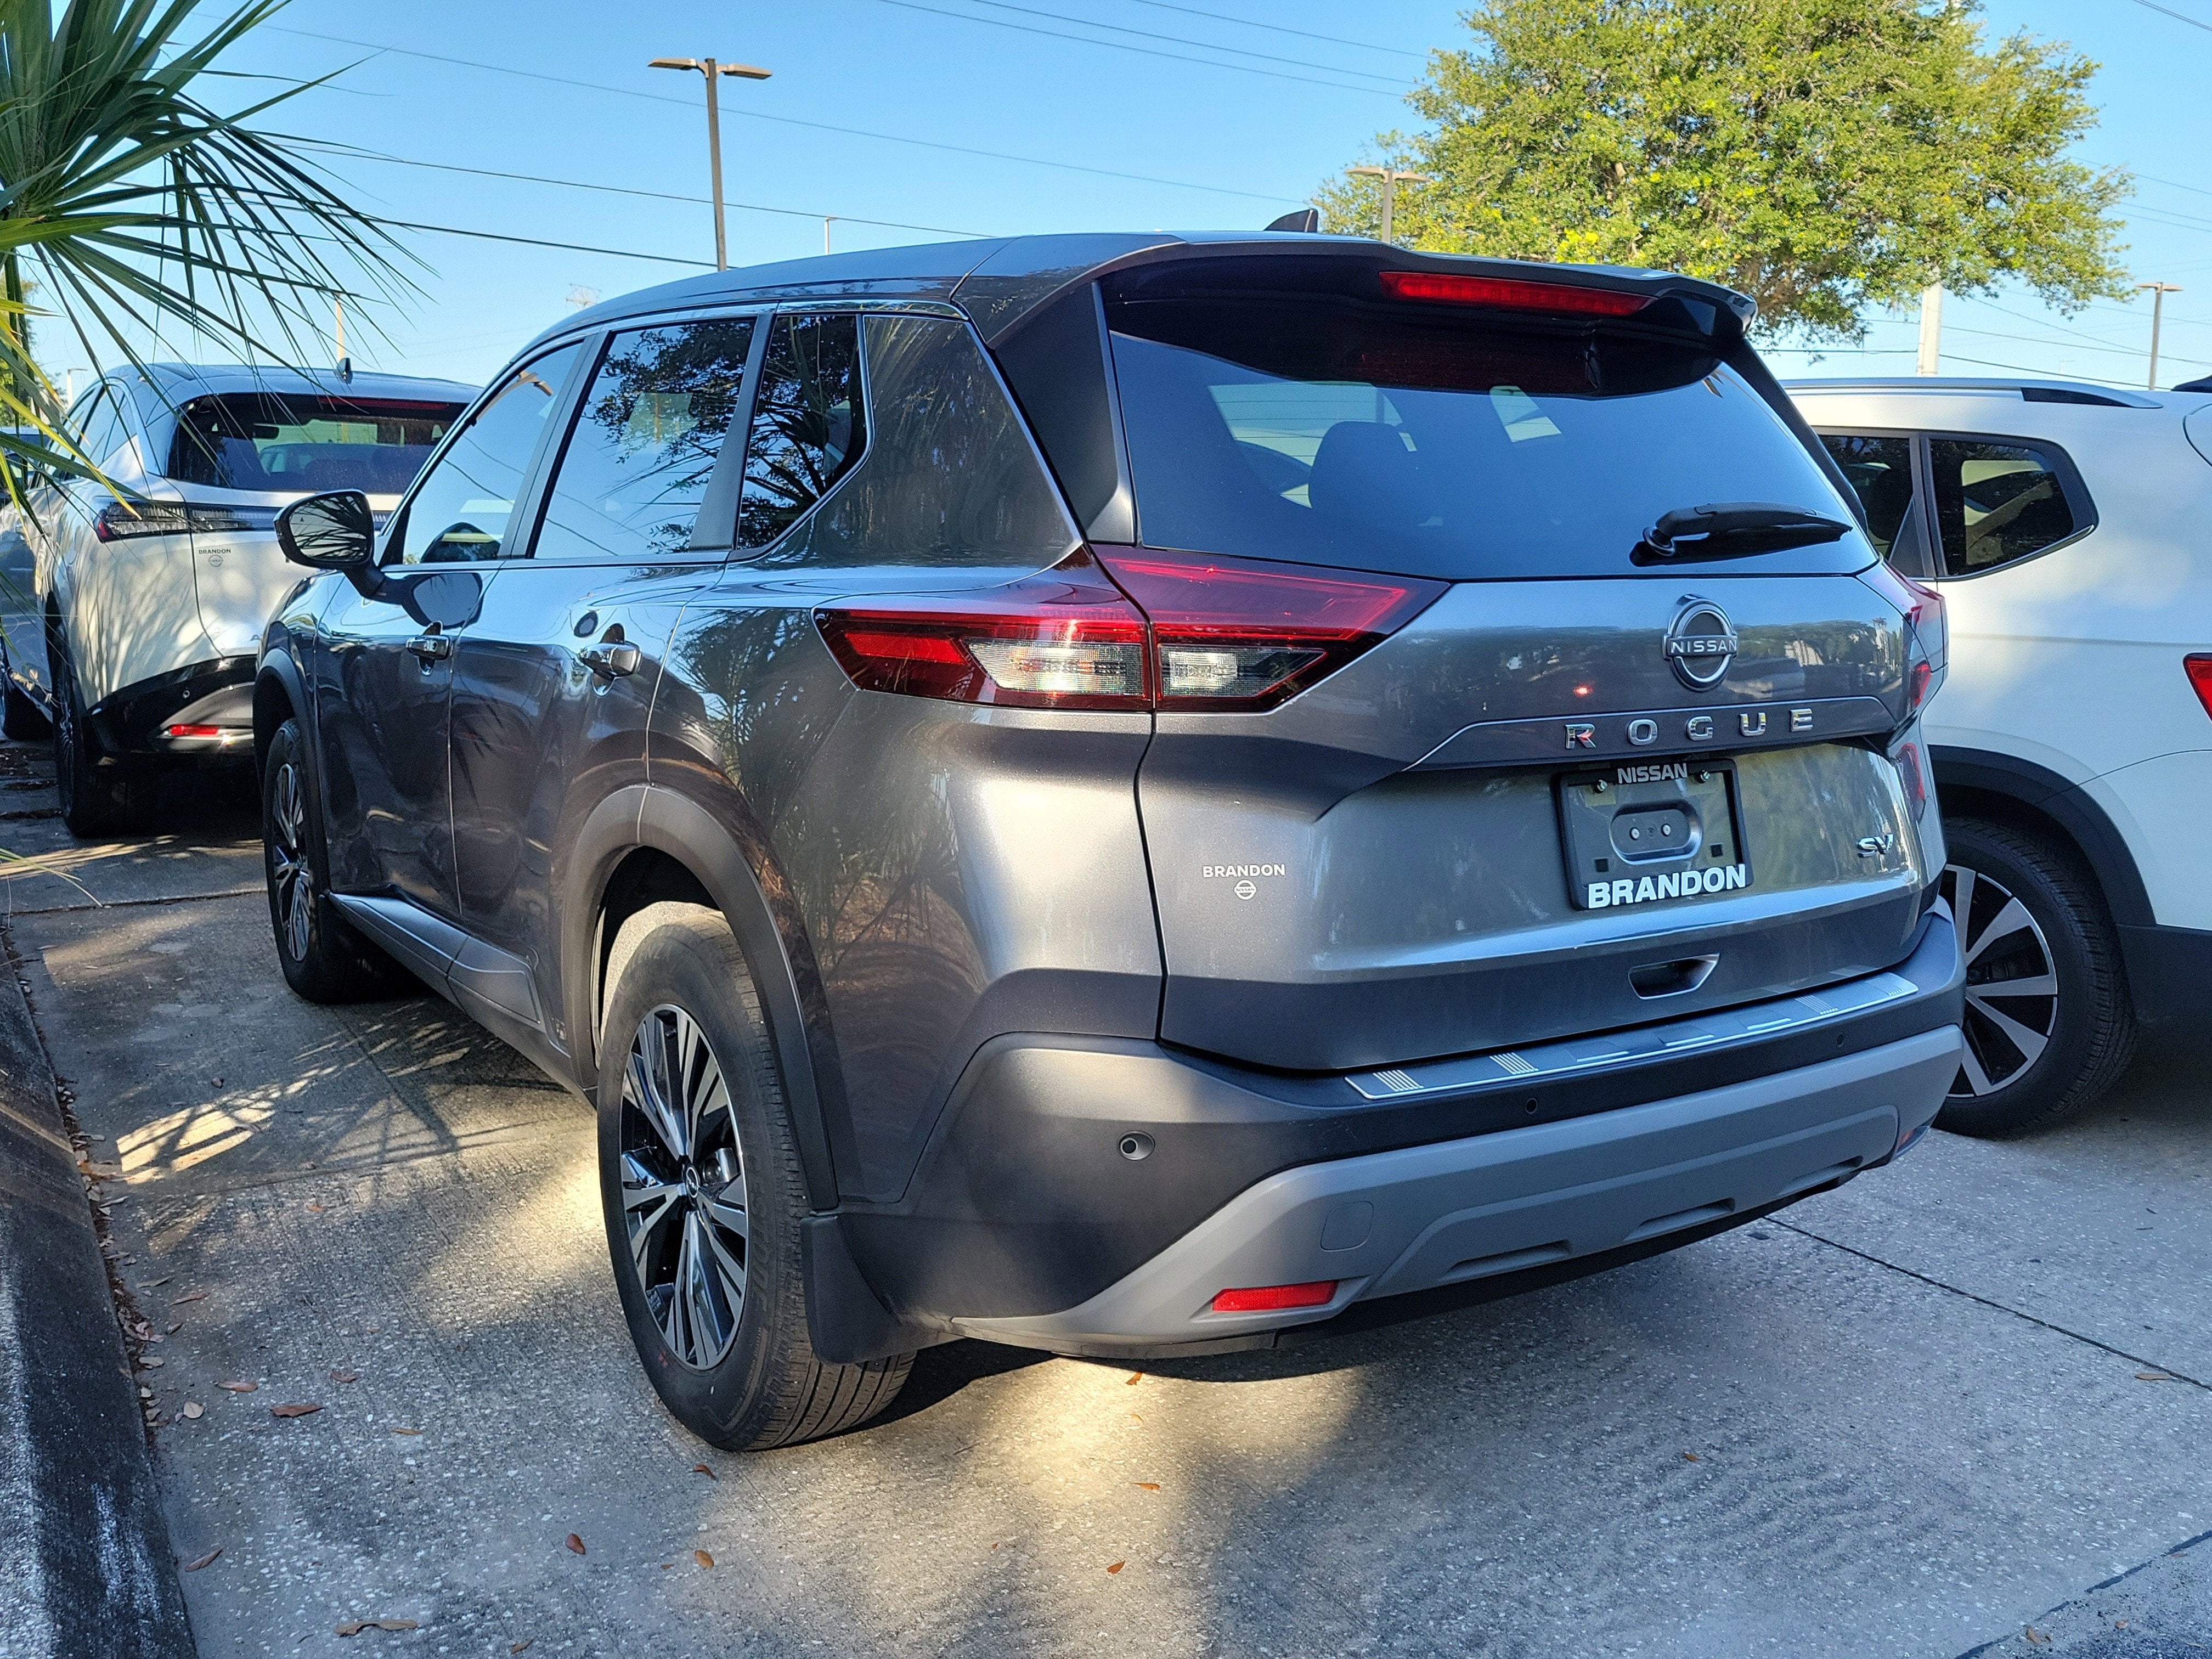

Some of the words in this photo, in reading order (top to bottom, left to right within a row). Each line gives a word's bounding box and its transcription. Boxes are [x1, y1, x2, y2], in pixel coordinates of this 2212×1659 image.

[1671, 640, 1737, 653] NISSAN
[1565, 708, 1814, 749] ROGUE
[1618, 763, 1688, 784] NISSAN
[1858, 834, 1893, 857] SV
[1203, 864, 1285, 878] BRANDON
[1588, 864, 1746, 909] BRANDON
